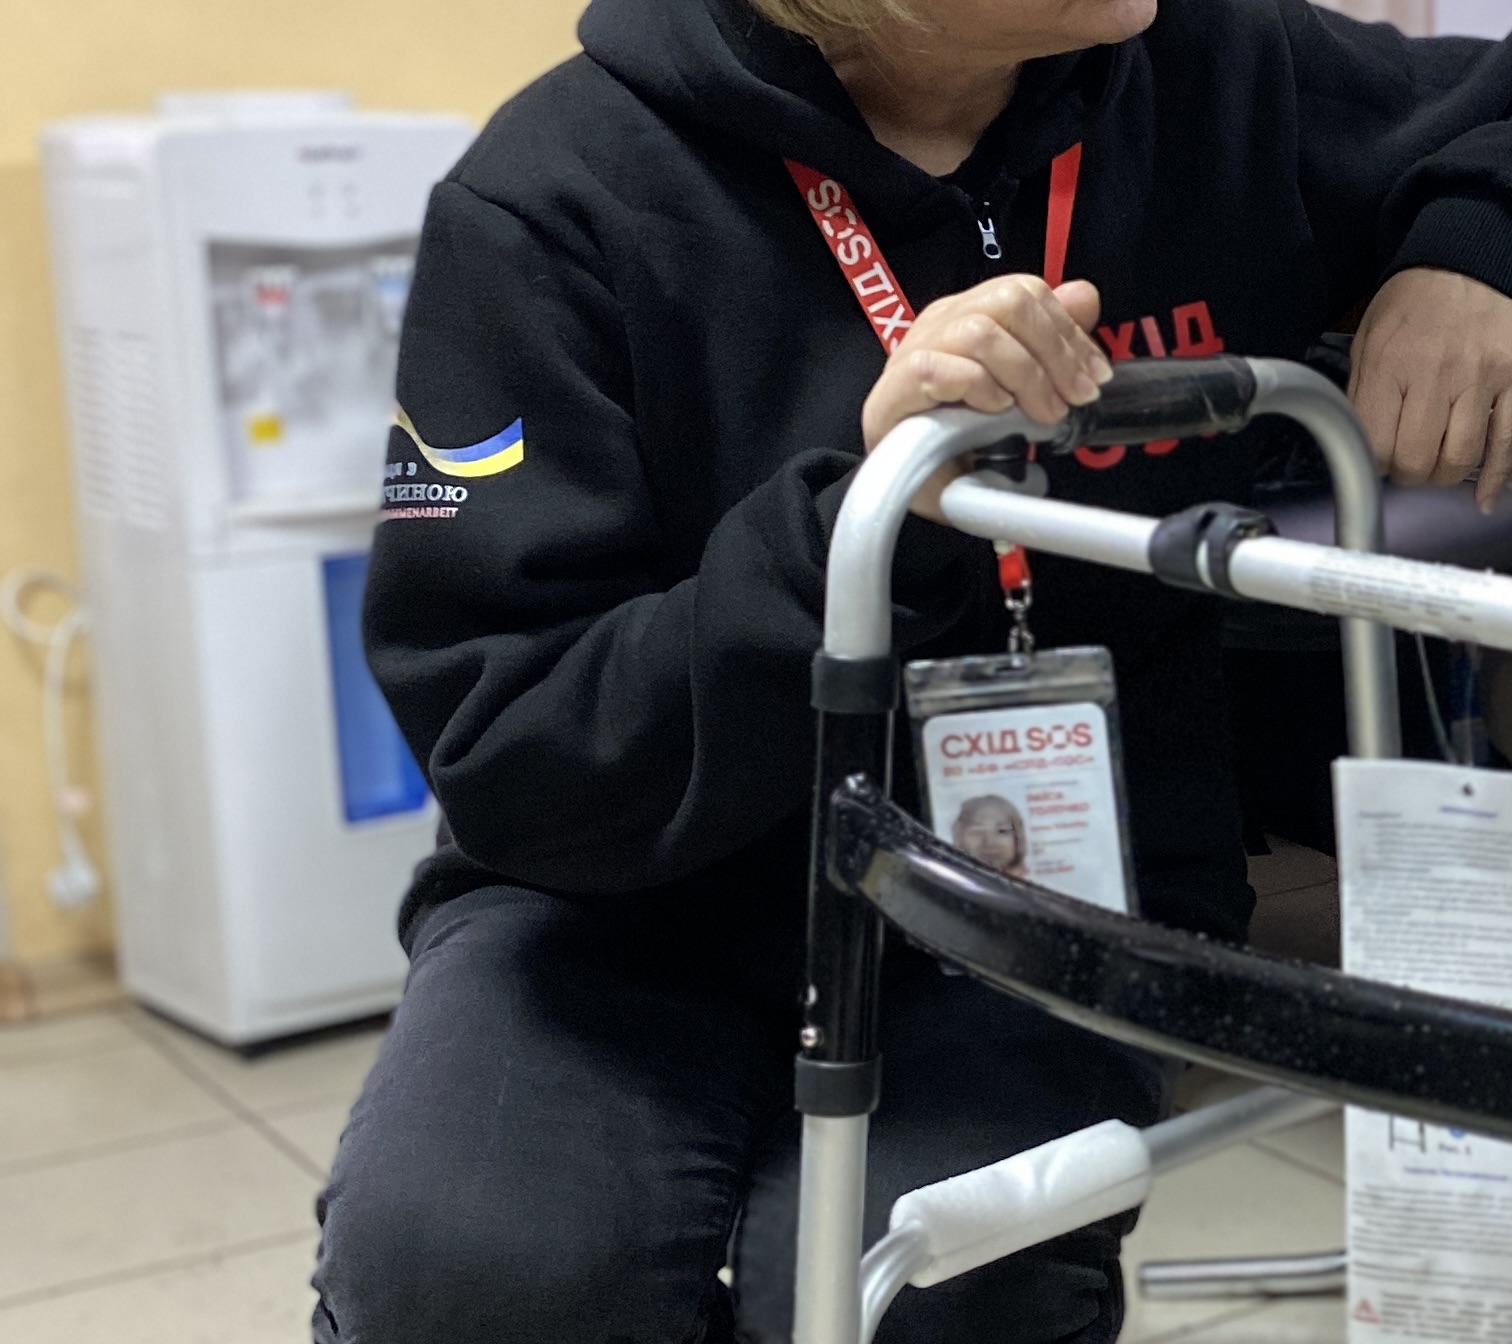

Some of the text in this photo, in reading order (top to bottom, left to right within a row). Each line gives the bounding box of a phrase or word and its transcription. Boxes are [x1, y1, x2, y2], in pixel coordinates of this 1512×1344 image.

[807, 178, 872, 265] SOS
[1097, 300, 1225, 362] ХІД
[940, 722, 1093, 759] СХІД SOS
